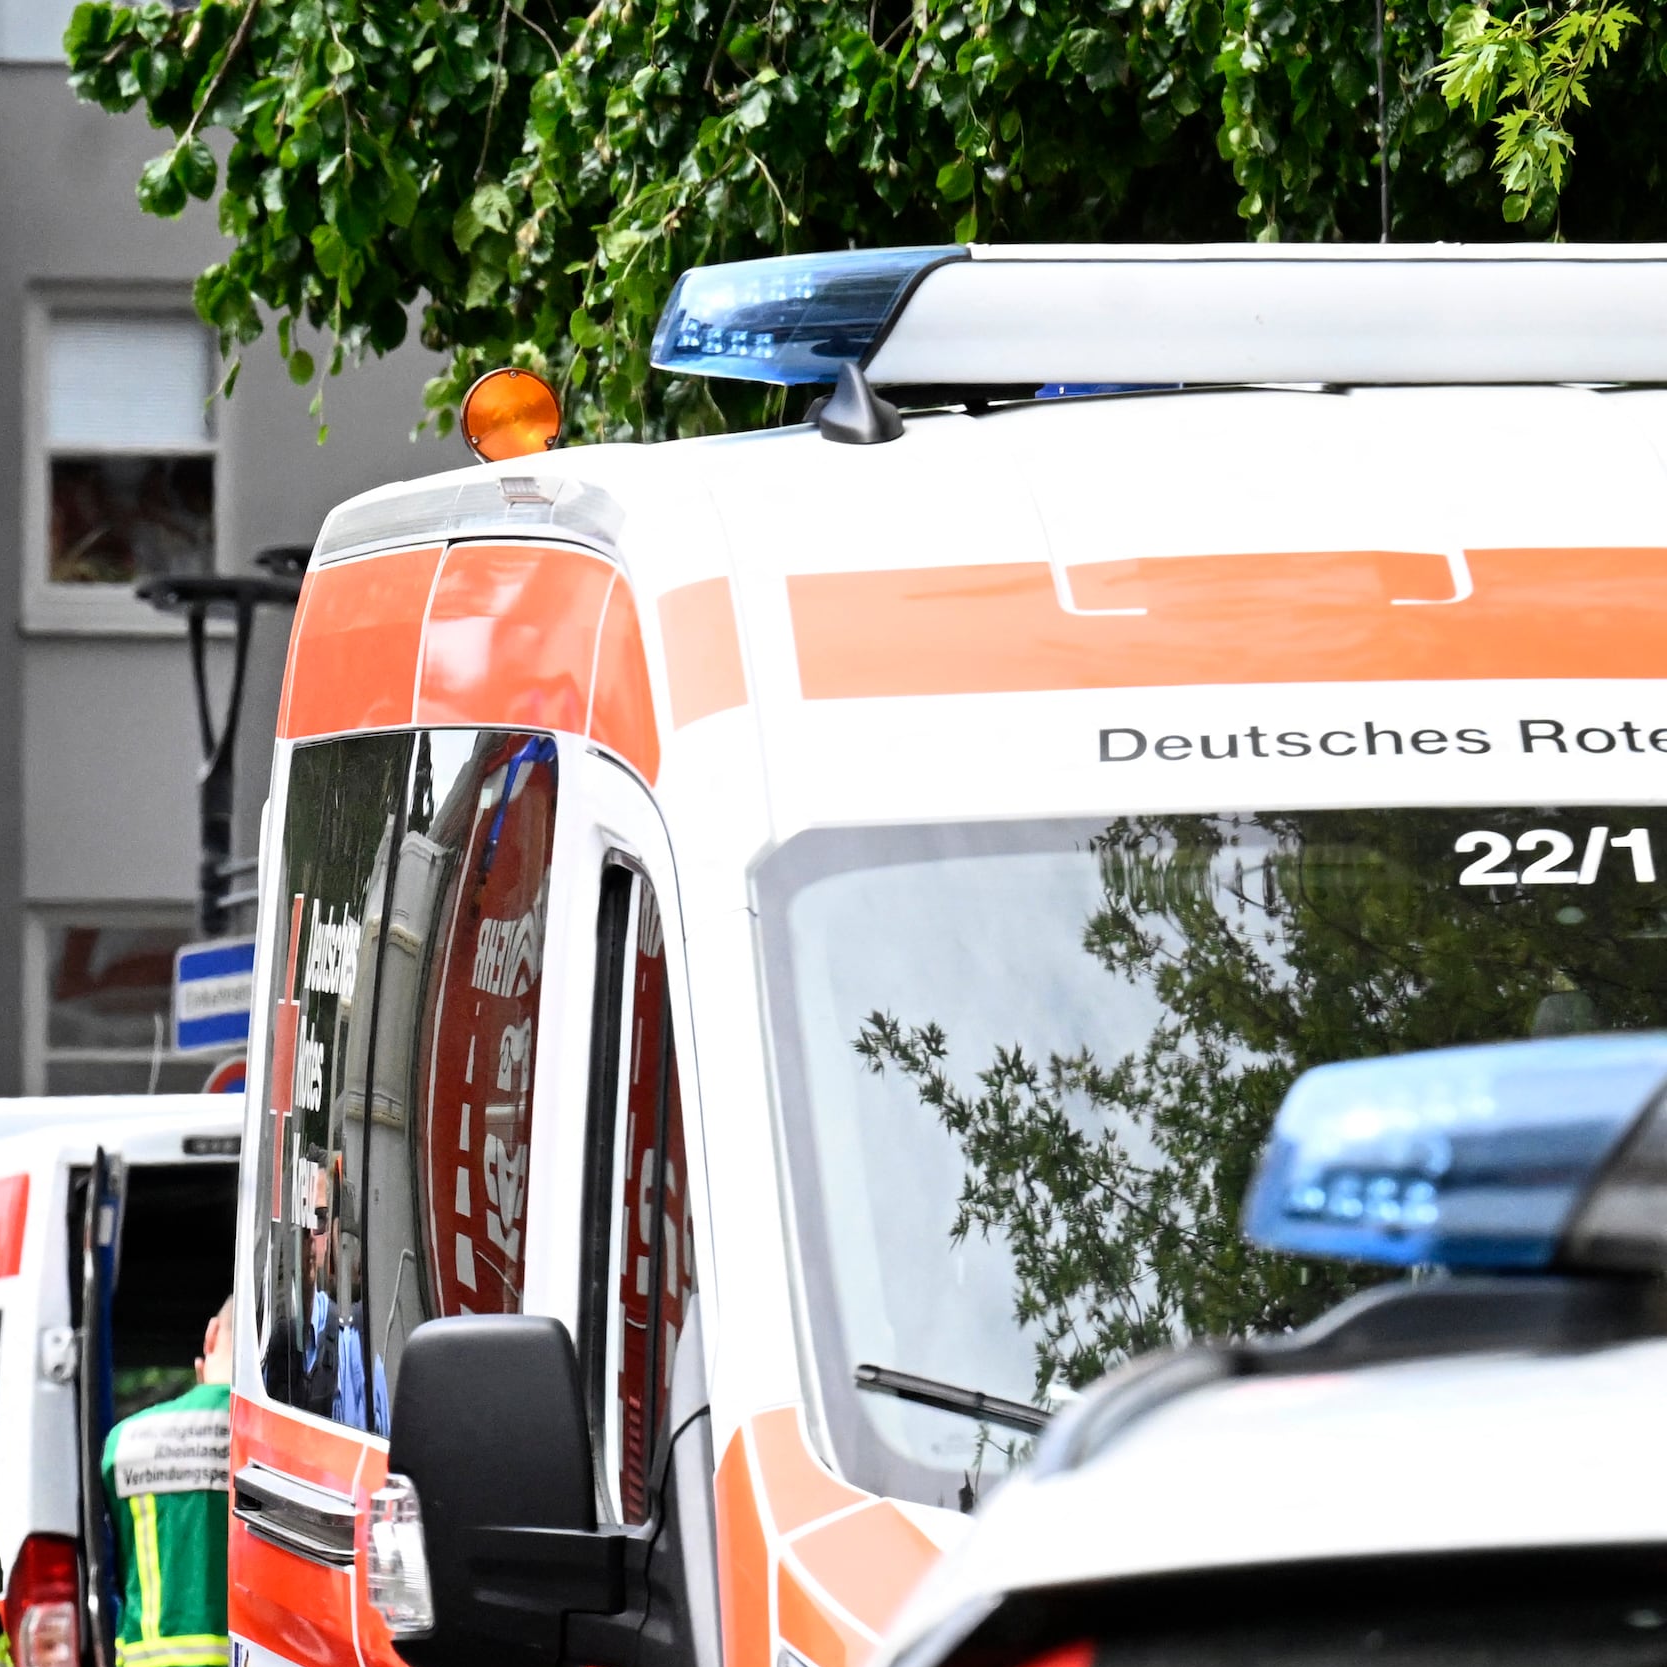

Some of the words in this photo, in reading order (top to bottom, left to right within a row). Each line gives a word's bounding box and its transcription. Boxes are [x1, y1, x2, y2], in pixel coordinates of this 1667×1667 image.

[1098, 721, 1492, 763] Deutsches
[1454, 826, 1656, 887] 22/1
[304, 898, 361, 999] Deutsches
[295, 1015, 323, 1112] Rotes
[291, 1132, 318, 1229] Kreuz
